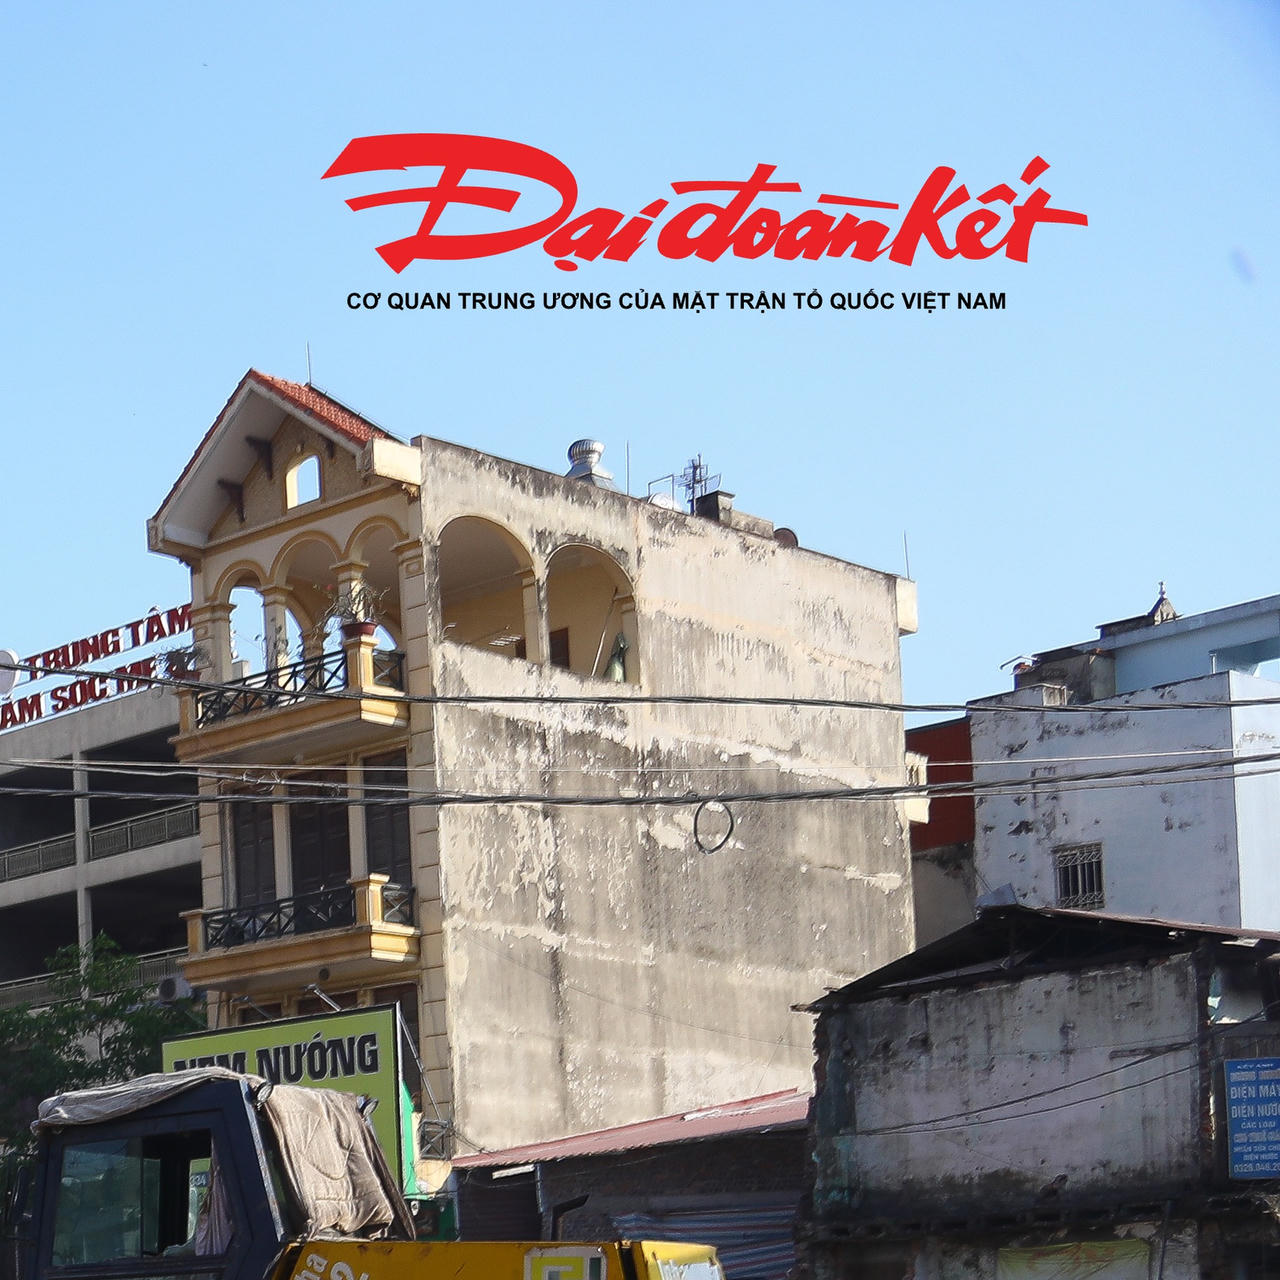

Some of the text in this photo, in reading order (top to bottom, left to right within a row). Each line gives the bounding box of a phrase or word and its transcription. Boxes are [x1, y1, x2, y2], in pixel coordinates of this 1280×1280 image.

[23, 604, 191, 682] TRUNG TÂM
[256, 1032, 380, 1084] NƯỚNG
